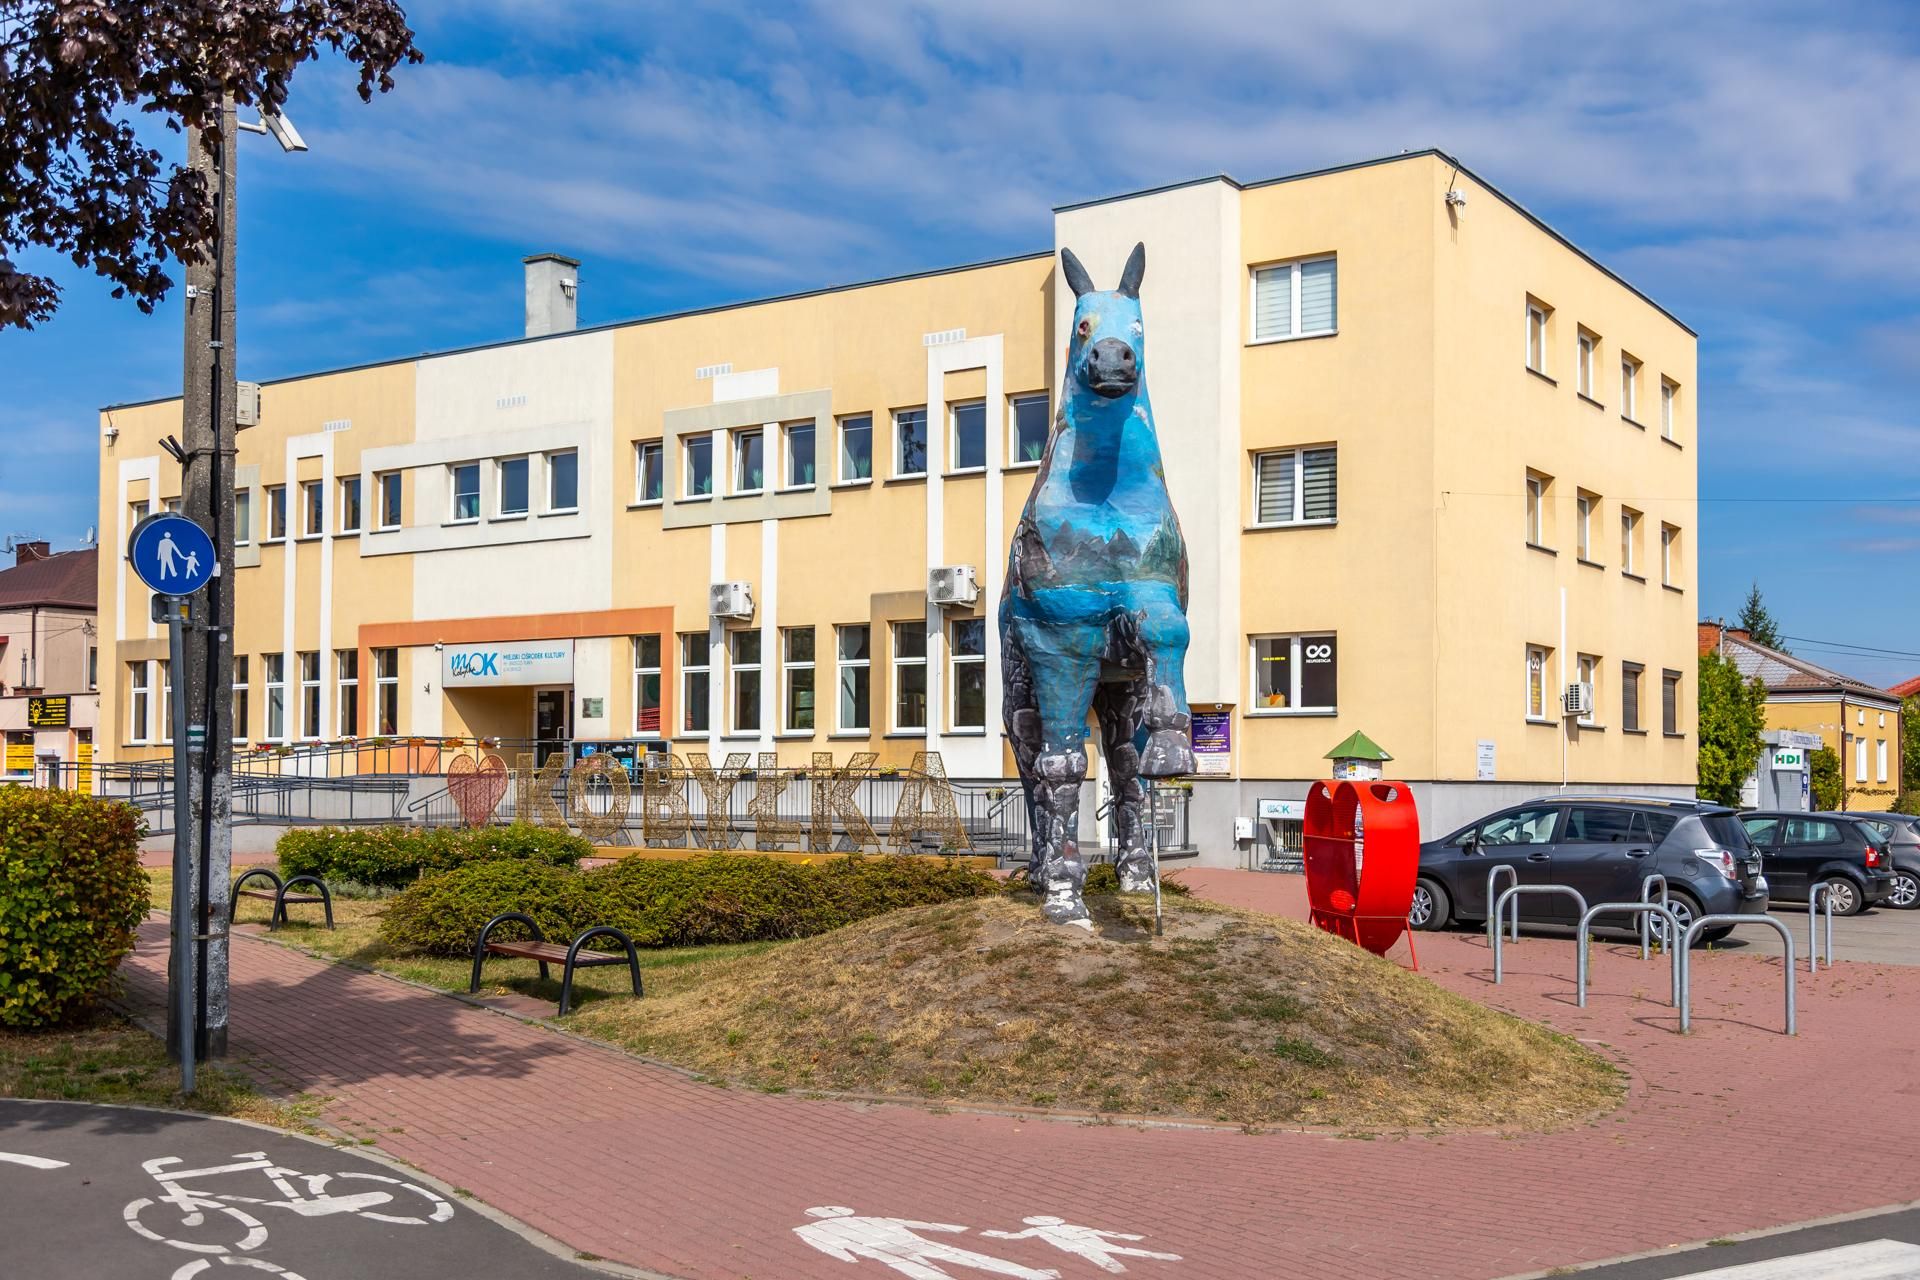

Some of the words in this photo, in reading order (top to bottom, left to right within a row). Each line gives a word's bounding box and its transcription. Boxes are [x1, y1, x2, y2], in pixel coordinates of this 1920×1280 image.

[521, 652, 543, 660] OŚRODEK
[545, 651, 565, 659] KULTURY
[1775, 754, 1801, 765] HDI
[516, 751, 970, 849] KOBYŁKA
